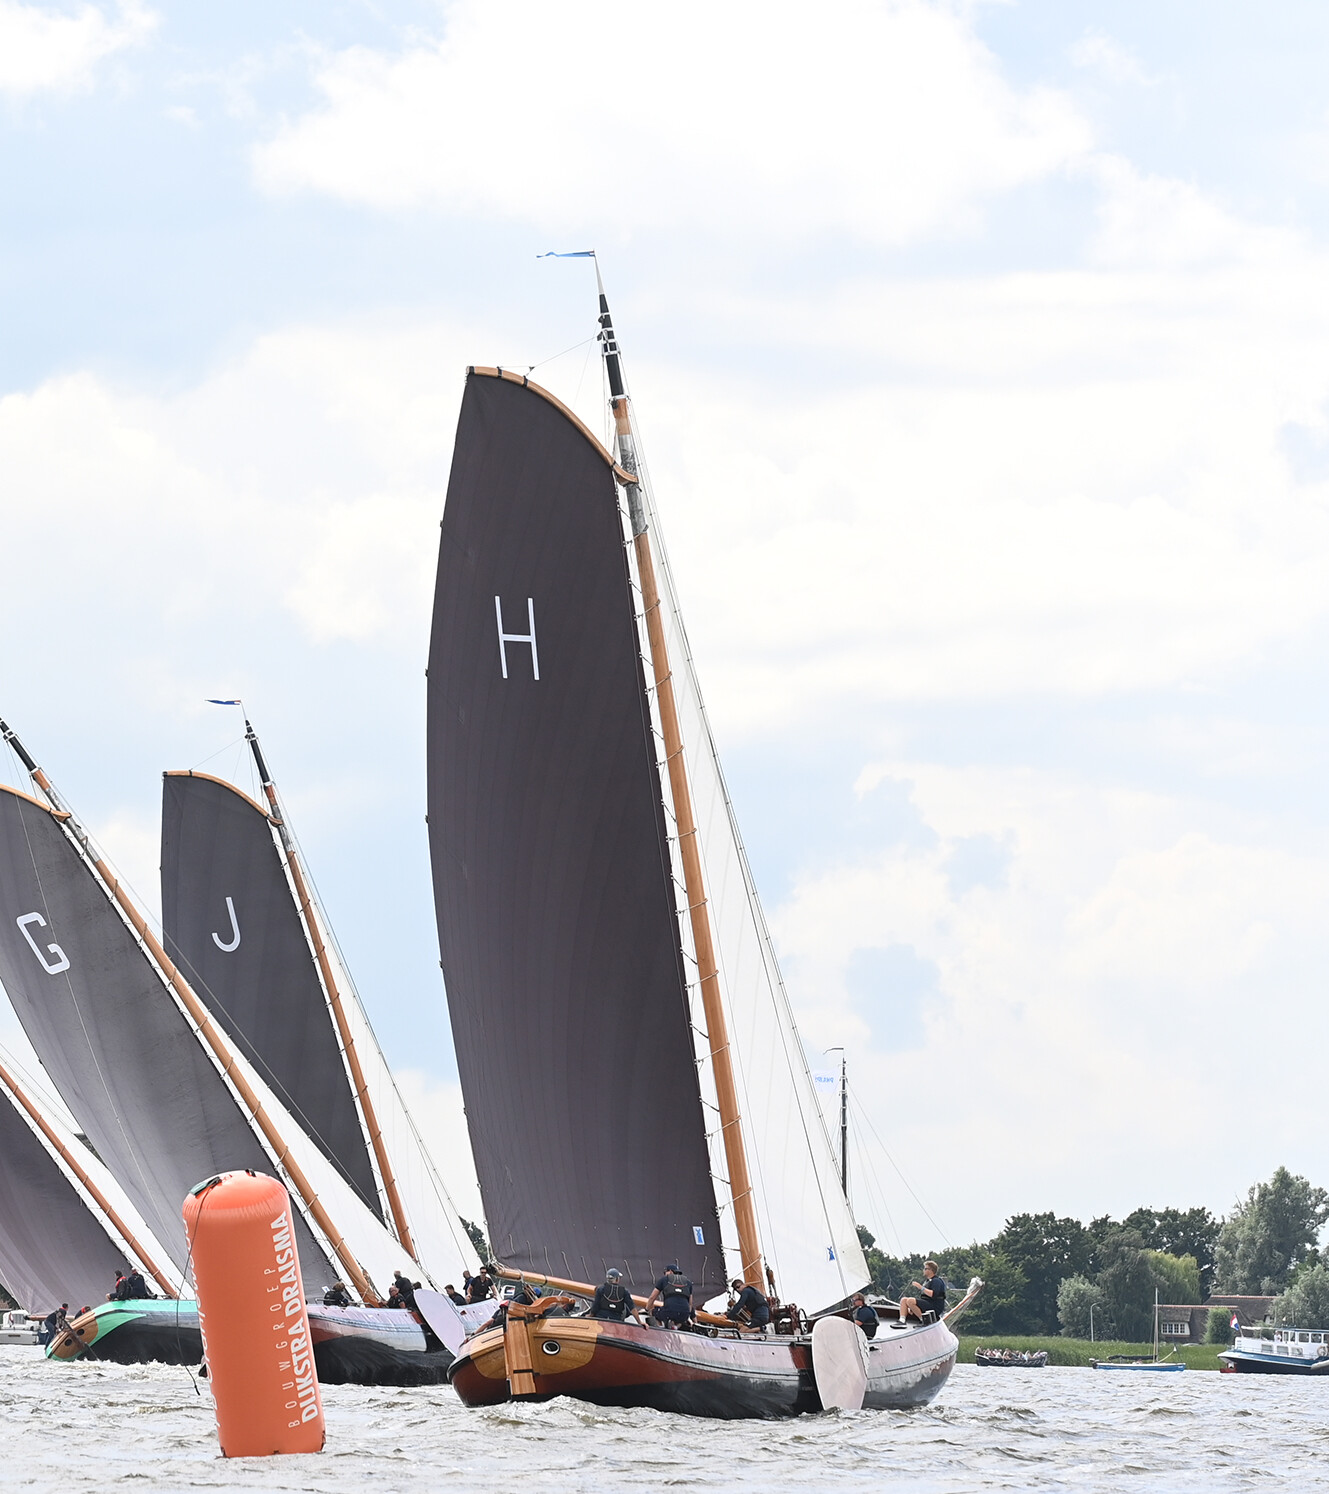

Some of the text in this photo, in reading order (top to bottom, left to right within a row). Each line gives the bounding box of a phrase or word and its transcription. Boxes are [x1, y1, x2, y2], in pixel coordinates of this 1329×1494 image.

[495, 595, 540, 681] H
[16, 911, 71, 976] G
[212, 896, 242, 953] J
[271, 1211, 319, 1424] DIJKSTRA DRAISMA
